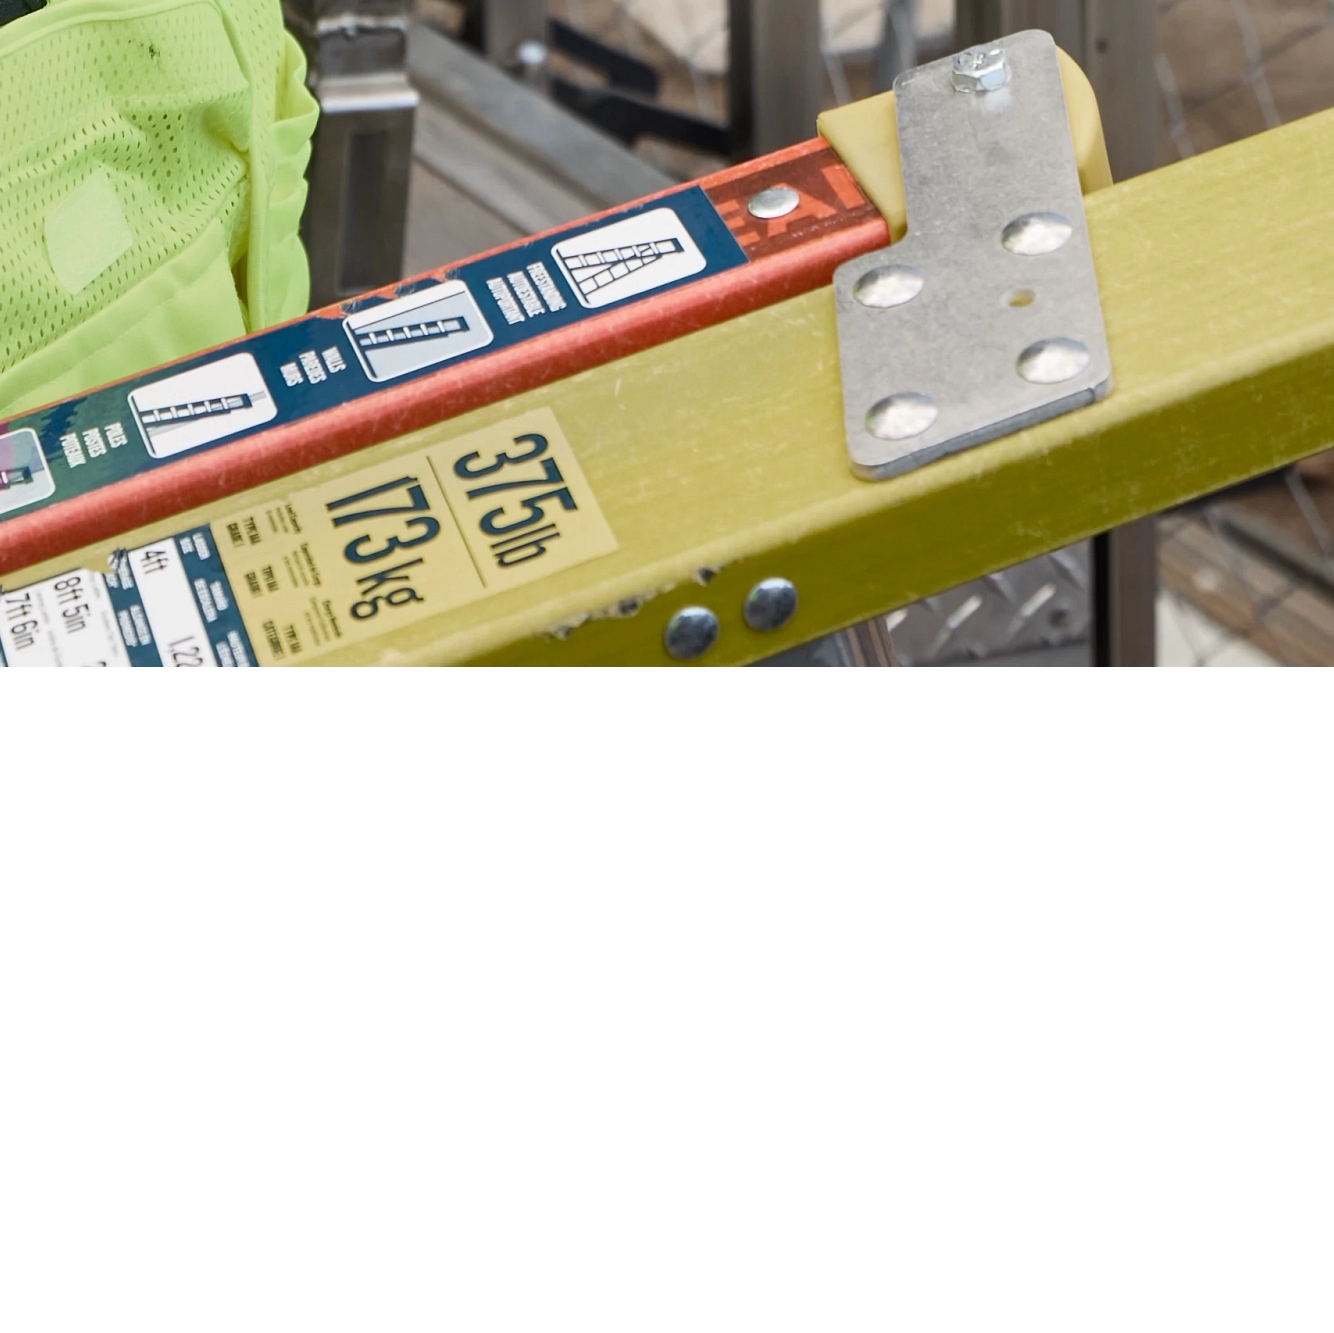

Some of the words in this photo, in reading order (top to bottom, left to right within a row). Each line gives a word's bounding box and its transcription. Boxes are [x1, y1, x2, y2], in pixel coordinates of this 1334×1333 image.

[525, 261, 567, 312] FREESTANDING
[297, 349, 327, 385] PAREDES
[321, 346, 346, 374] WALLS
[82, 427, 107, 458] POSTES
[105, 422, 127, 448] POLES
[60, 433, 86, 468] POTEAUX
[140, 550, 169, 574] 4ft
[54, 576, 82, 605] 8ft
[5, 593, 32, 620] 7ft
[62, 603, 91, 633] 5in
[10, 620, 38, 649] 6in
